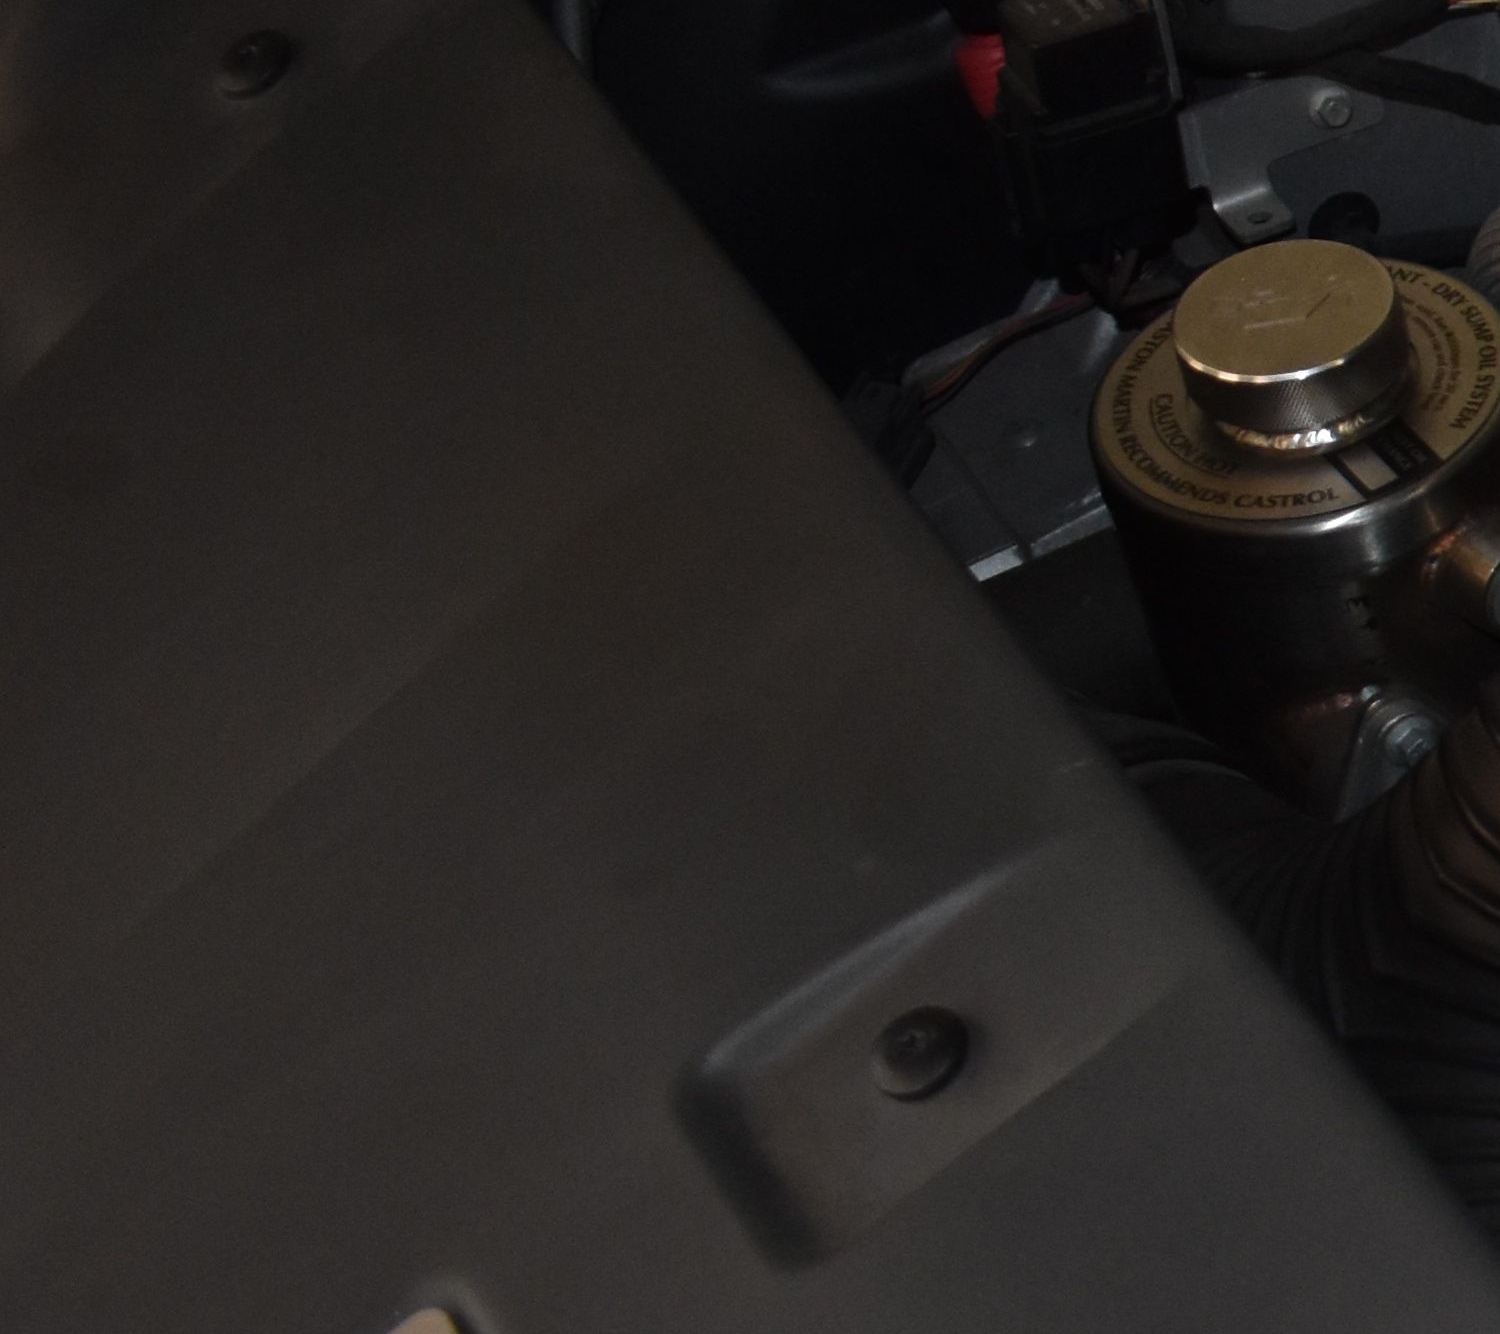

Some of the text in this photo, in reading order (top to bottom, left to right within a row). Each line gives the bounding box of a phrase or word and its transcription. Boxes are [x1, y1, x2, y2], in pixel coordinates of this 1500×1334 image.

[1432, 282, 1467, 307] DRY
[1461, 304, 1495, 341] SUMP
[1479, 346, 1498, 371] OIL
[1112, 374, 1137, 434] MARTIN
[1449, 374, 1495, 429] SYSTEM
[1155, 393, 1239, 478] CAUTION HOT
[1118, 434, 1230, 505] RECOMMENDS
[1233, 487, 1341, 509] CASTROL
